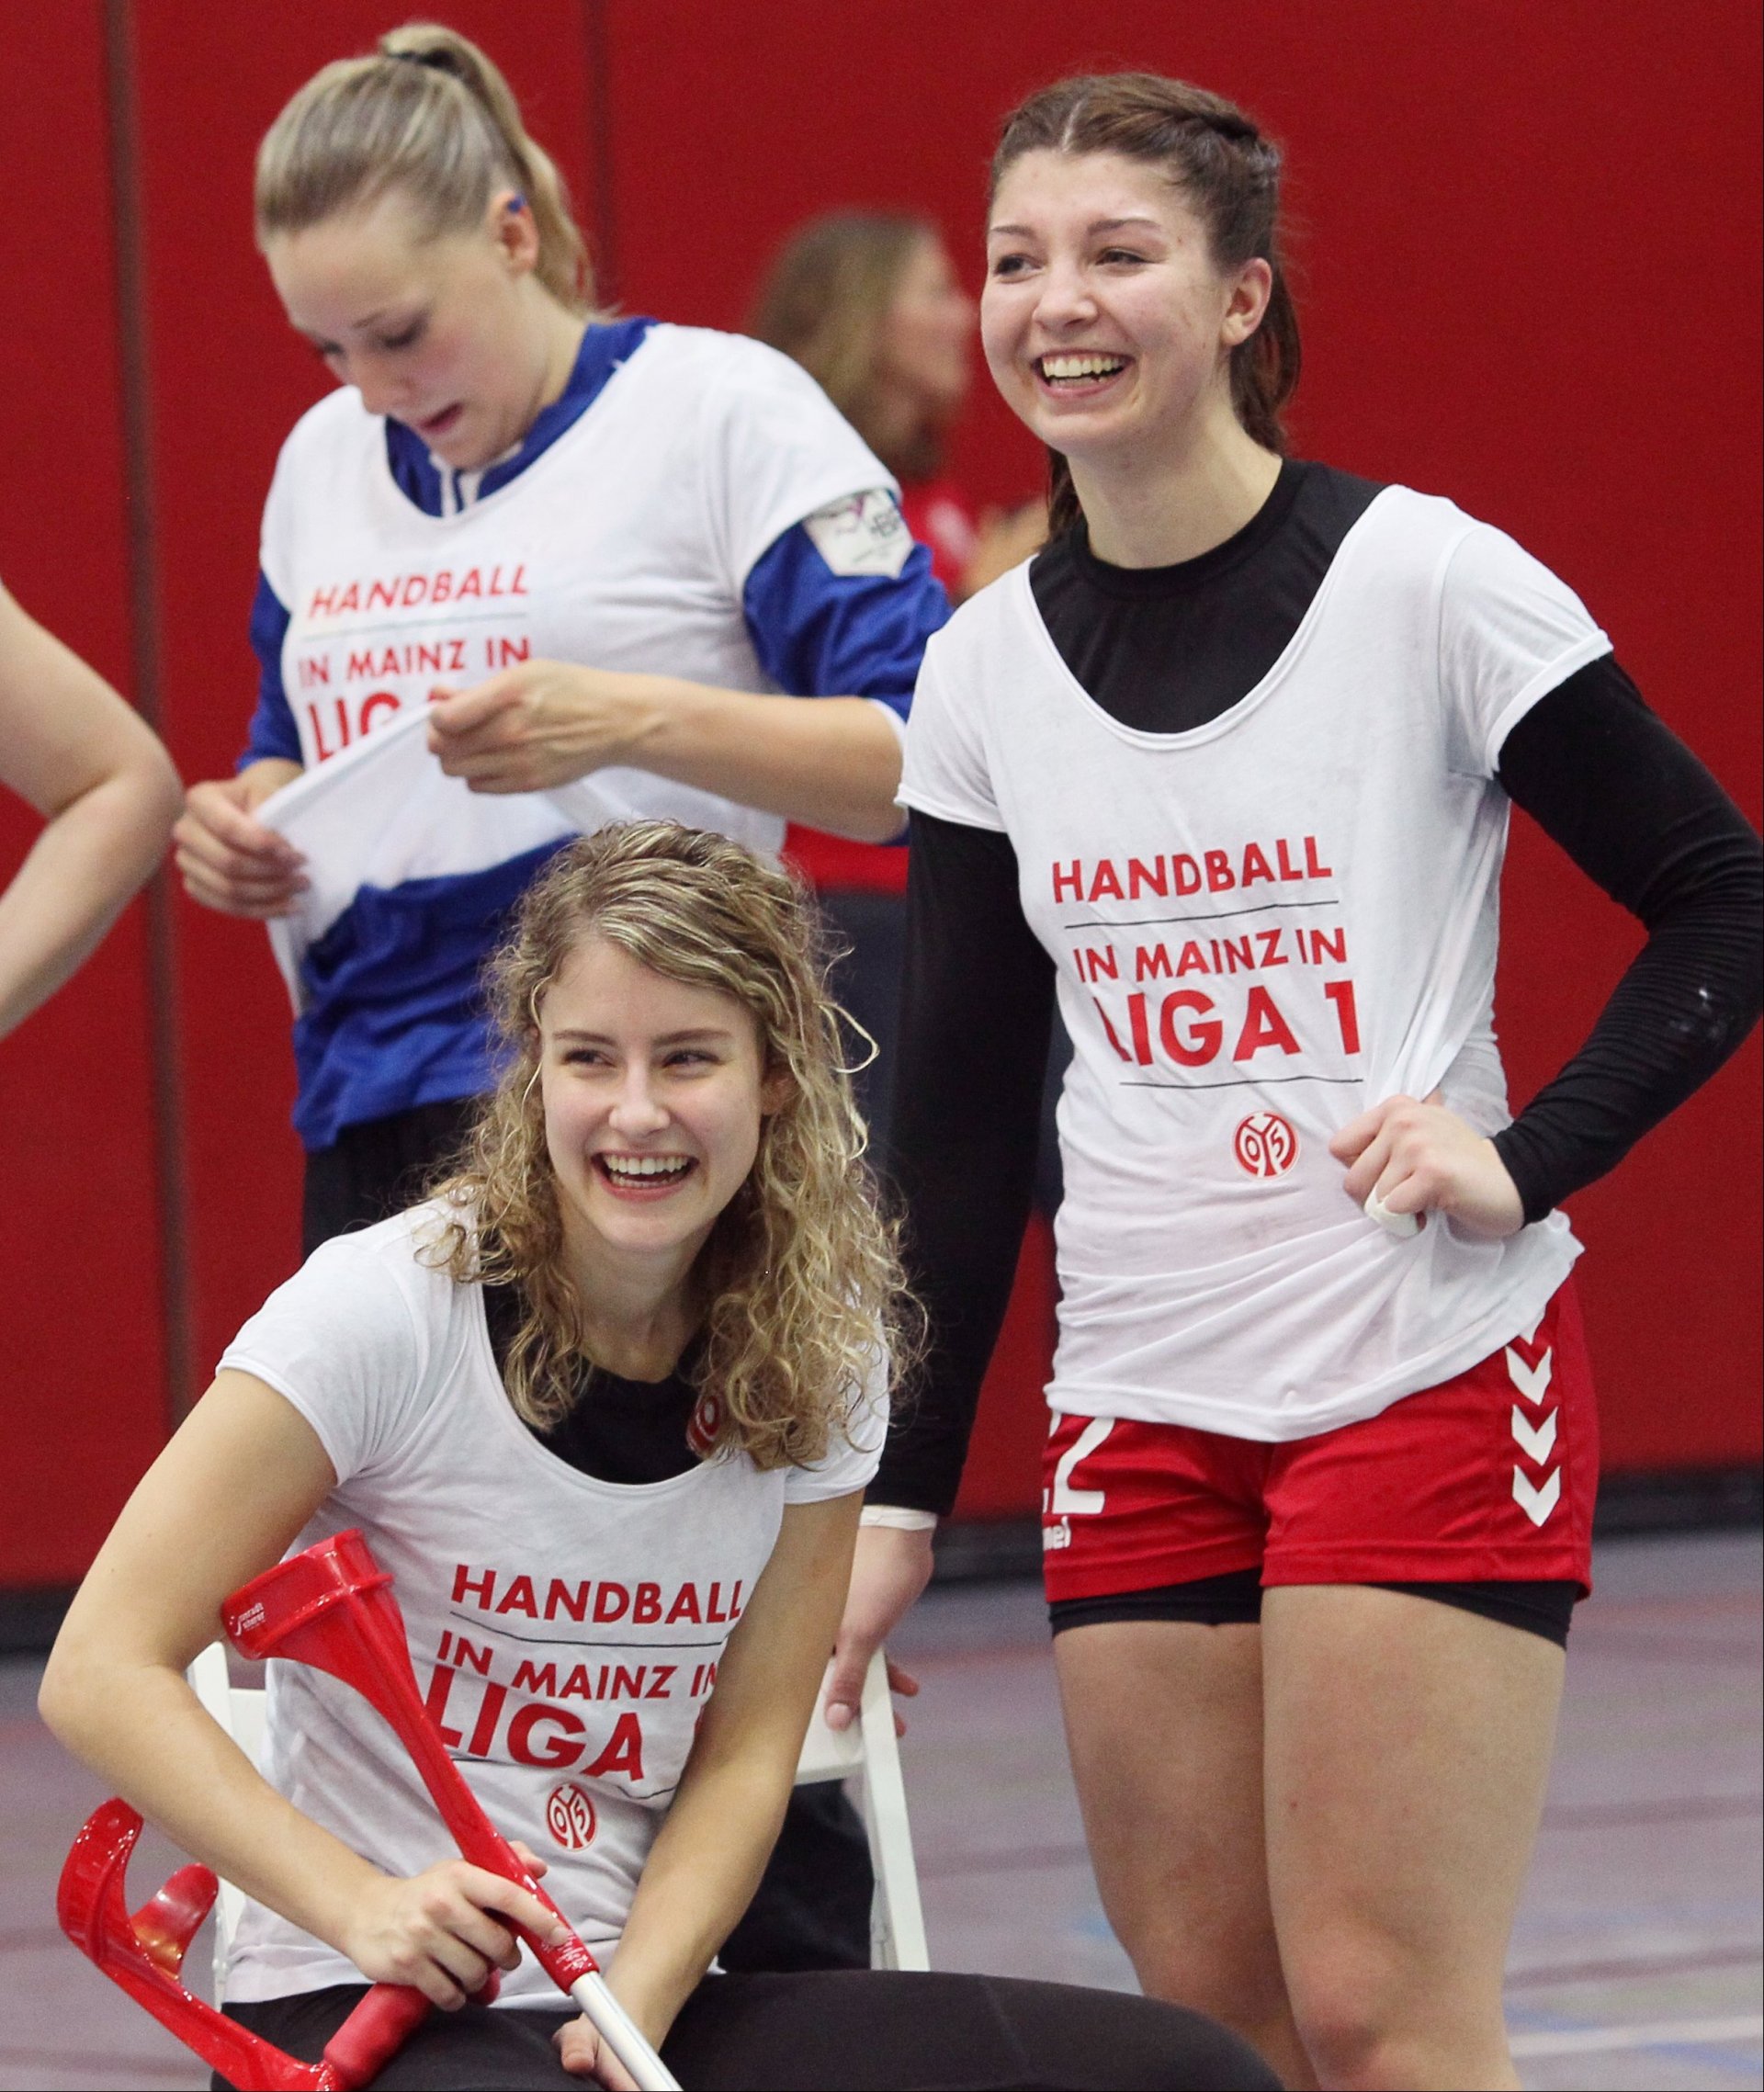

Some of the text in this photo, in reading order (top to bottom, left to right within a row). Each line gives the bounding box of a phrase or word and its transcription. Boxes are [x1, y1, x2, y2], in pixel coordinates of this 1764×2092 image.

[308, 564, 528, 618] HANDBALL
[346, 638, 466, 683] MAINZ
[485, 637, 530, 669] IN
[1052, 835, 1334, 905] HANDBALL
[1073, 926, 1349, 984] IN MAINZ IN
[1323, 978, 1363, 1057] 1
[450, 1563, 743, 1625] HANDBALL
[435, 1629, 494, 1677] IN
[511, 1659, 678, 1702] MAINZ
[424, 1662, 646, 1783] LIGA
